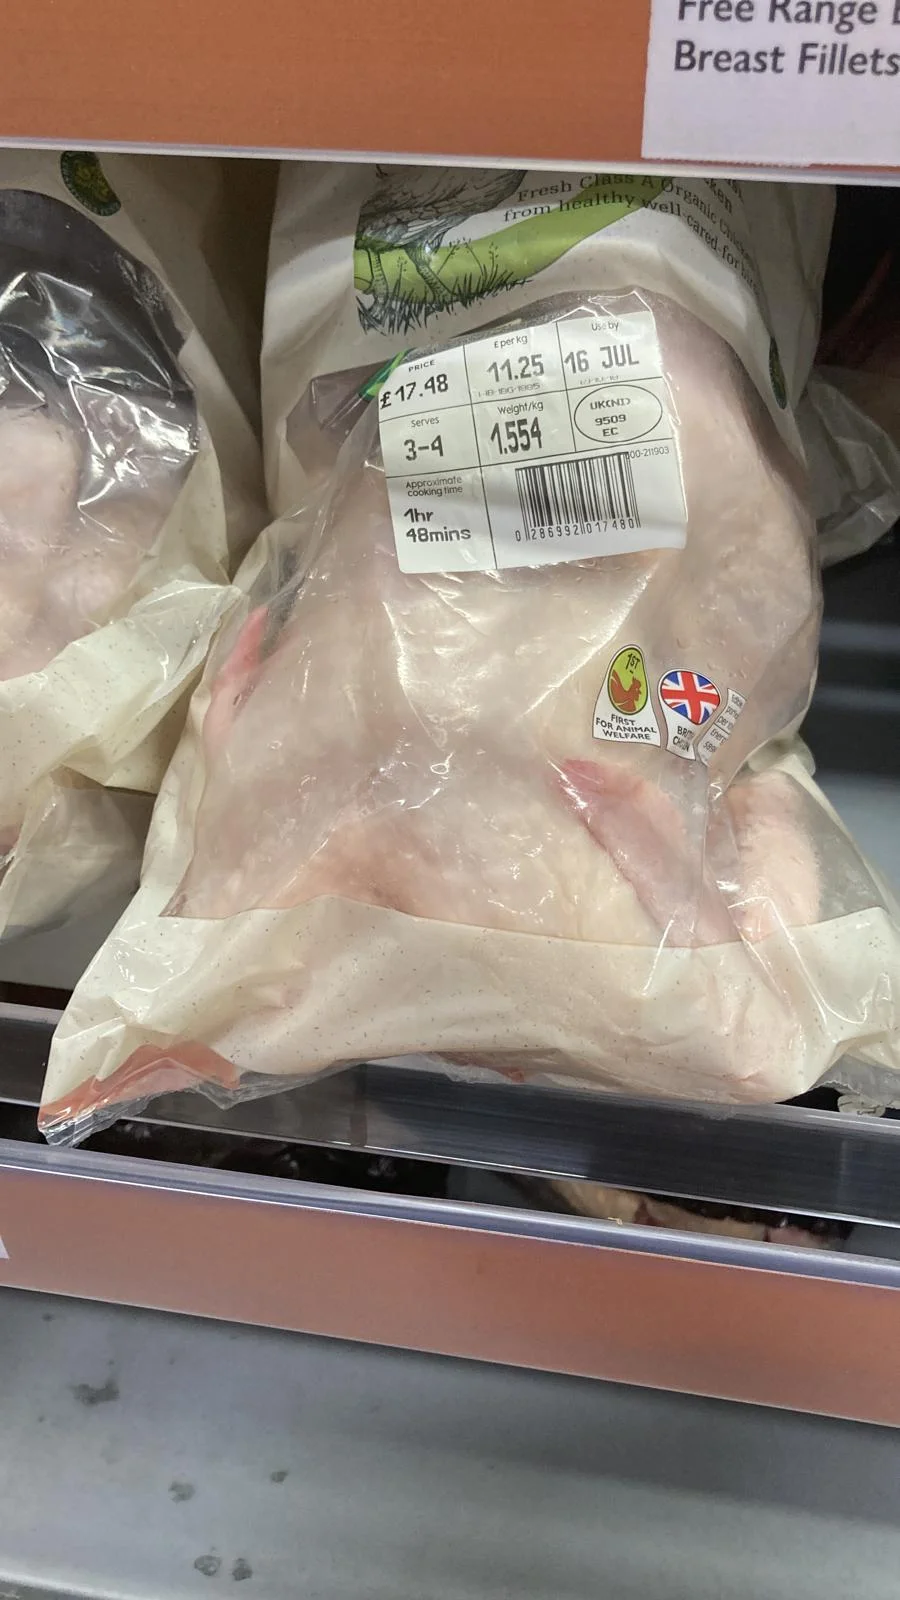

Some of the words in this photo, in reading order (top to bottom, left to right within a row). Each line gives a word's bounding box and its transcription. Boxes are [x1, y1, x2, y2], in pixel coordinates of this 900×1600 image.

[678, 0, 754, 22] Free
[768, 0, 878, 34] Range
[674, 39, 785, 74] Breast
[797, 41, 900, 76] Fillets
[503, 204, 551, 222] from
[559, 190, 635, 212] healthy
[517, 179, 572, 202] Fresh
[580, 173, 634, 189] Class
[641, 176, 654, 189] A
[661, 177, 718, 224] Organic
[608, 321, 619, 332] by
[500, 338, 514, 349] per
[516, 335, 528, 345] kg
[409, 360, 436, 372] PRICE
[564, 350, 590, 374] 16
[600, 344, 640, 369] JUL
[487, 354, 545, 382] 11.25
[380, 373, 449, 410] £17.48
[497, 401, 544, 415] Weight/kg
[411, 416, 440, 428] Serves
[595, 414, 627, 426] 9509
[490, 416, 542, 455] 1.554
[602, 427, 618, 437] EC
[404, 434, 444, 461] 3-4
[406, 476, 462, 490] Approximate
[407, 487, 443, 497] cooking
[443, 486, 463, 495] time
[403, 508, 434, 523] 1hr
[406, 526, 471, 543] 48mins
[626, 653, 640, 670] 1ST
[595, 717, 614, 730] FOR
[616, 725, 657, 734] ANIMAL
[610, 714, 636, 726] FIRST
[602, 729, 651, 740] WELFARE
